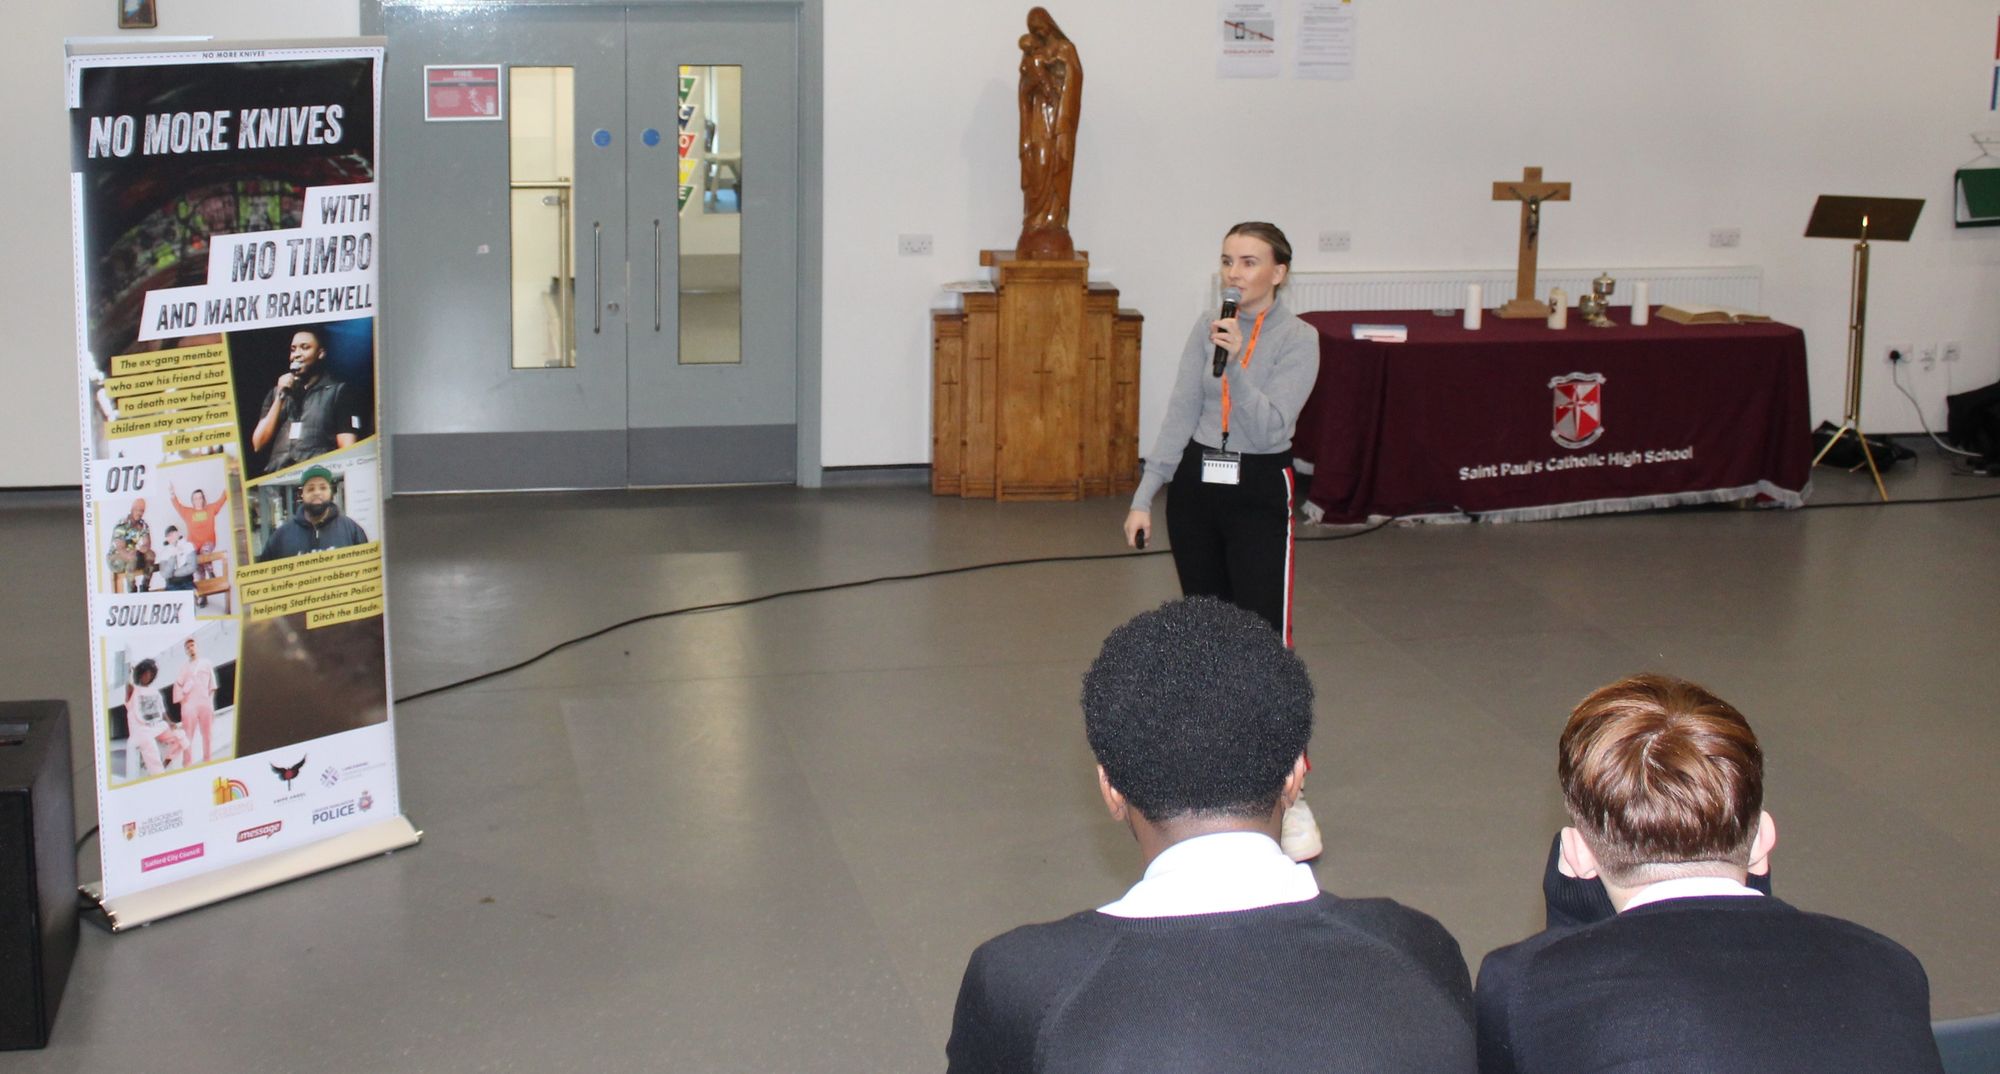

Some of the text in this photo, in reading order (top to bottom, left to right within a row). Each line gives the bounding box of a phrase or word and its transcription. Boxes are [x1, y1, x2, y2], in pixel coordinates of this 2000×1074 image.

[88, 104, 345, 158] NO MORE KNIVES
[320, 193, 372, 225] WITH
[231, 232, 373, 283] MO TIMBO
[156, 284, 373, 331] AND MARK BRACEWELL
[121, 349, 223, 370] The ex-gang member
[110, 368, 225, 392] who saw his friend shot
[125, 388, 227, 412] to death now helping
[111, 410, 229, 435] children stay away from
[166, 430, 231, 447] a life of crime
[1459, 445, 1693, 480] Saint Paul's Catholic High School
[105, 464, 146, 494] OTC
[236, 567, 269, 579] Former
[271, 562, 295, 575] gang
[296, 553, 335, 568] member
[336, 545, 379, 560] sentenced
[247, 565, 379, 598] for a knife-point robbery now
[105, 602, 183, 628] SOULBOX
[253, 584, 376, 616] helping Staffordshire Police
[313, 611, 335, 623] Ditch
[337, 606, 351, 617] the
[312, 803, 355, 825] POLICE
